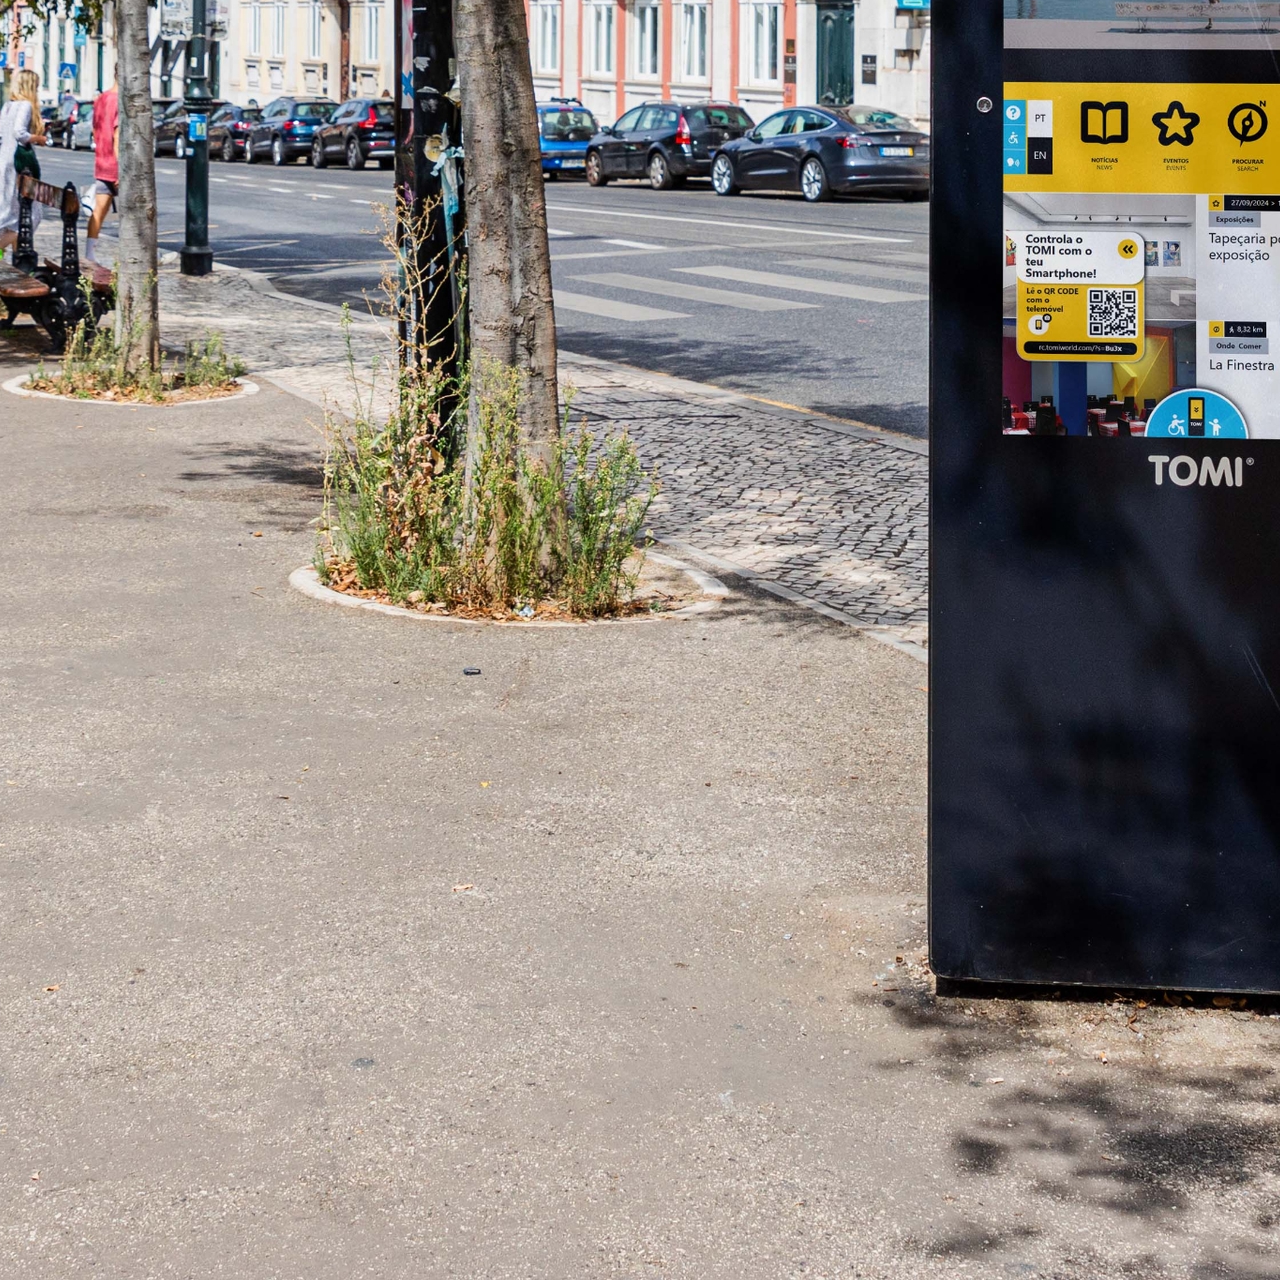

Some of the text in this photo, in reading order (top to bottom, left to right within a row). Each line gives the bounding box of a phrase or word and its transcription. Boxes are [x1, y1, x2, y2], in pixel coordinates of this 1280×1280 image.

[1034, 114, 1046, 122] PT
[1033, 151, 1047, 160] EN
[1216, 216, 1254, 224] Exposições
[1025, 234, 1072, 244] Controla
[1209, 232, 1266, 246] Tapeçaria
[1025, 246, 1055, 255] TOMI
[1209, 249, 1270, 263] exposição
[1025, 258, 1043, 266] teu
[1025, 268, 1097, 280] Smartphone!
[1026, 305, 1064, 313] telemóvel
[1209, 359, 1275, 371] La Finestra
